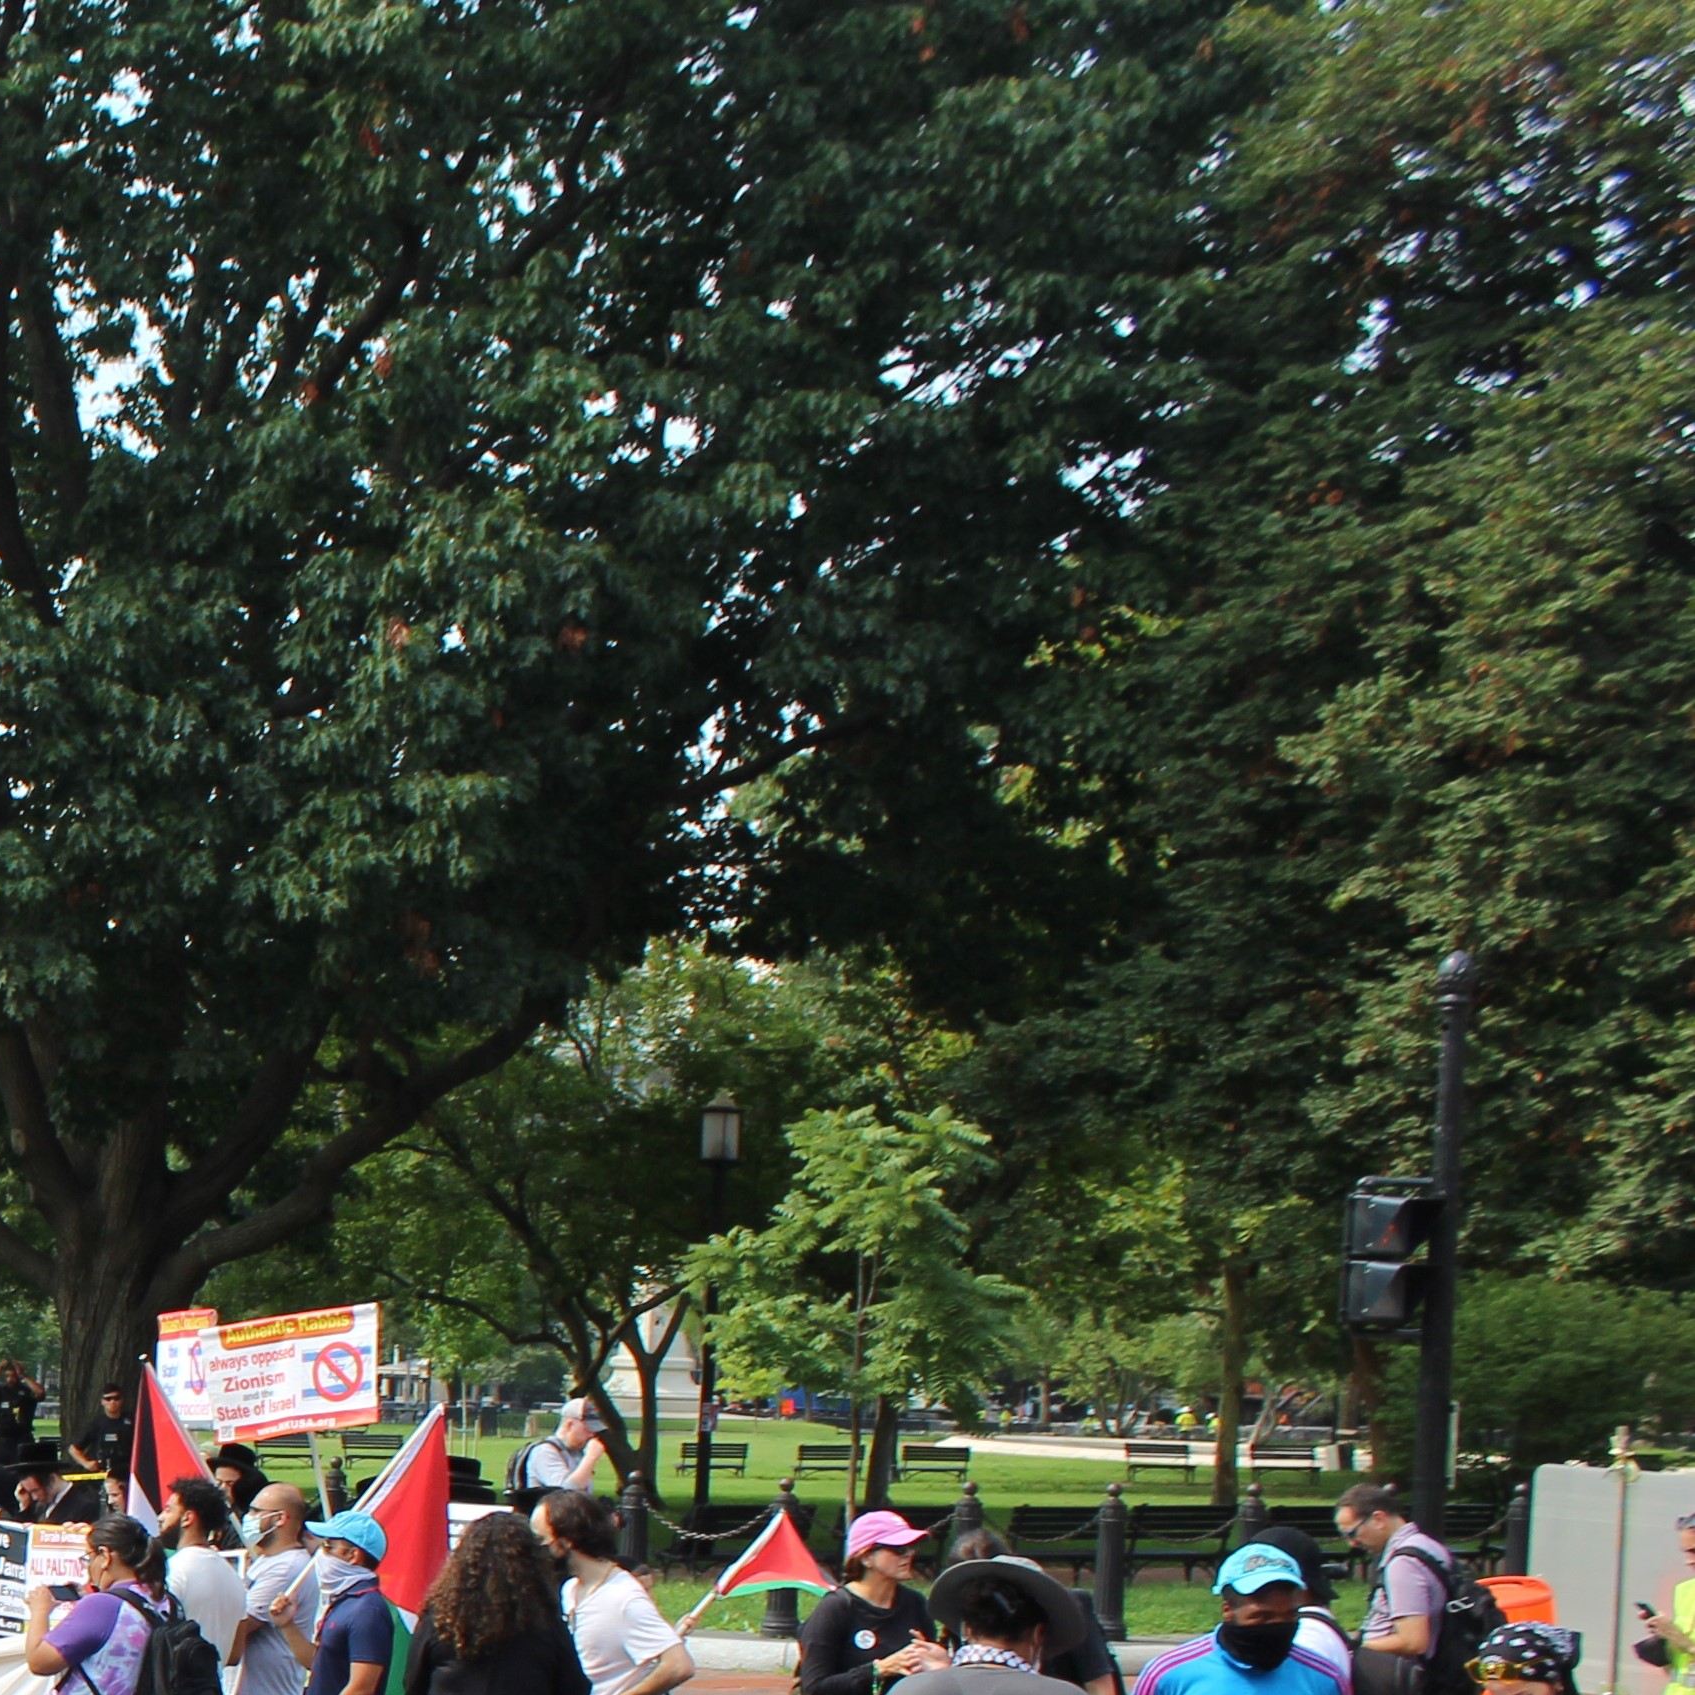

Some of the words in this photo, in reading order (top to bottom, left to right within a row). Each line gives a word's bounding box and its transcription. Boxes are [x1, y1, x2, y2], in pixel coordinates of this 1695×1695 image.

[225, 1320, 296, 1344] Authentic
[298, 1312, 351, 1335] Rabbis
[209, 1354, 248, 1372] always
[251, 1345, 296, 1366] opposed
[223, 1371, 285, 1393] Zionism
[216, 1403, 250, 1421] State
[253, 1402, 266, 1416] of
[268, 1395, 297, 1413] Israel
